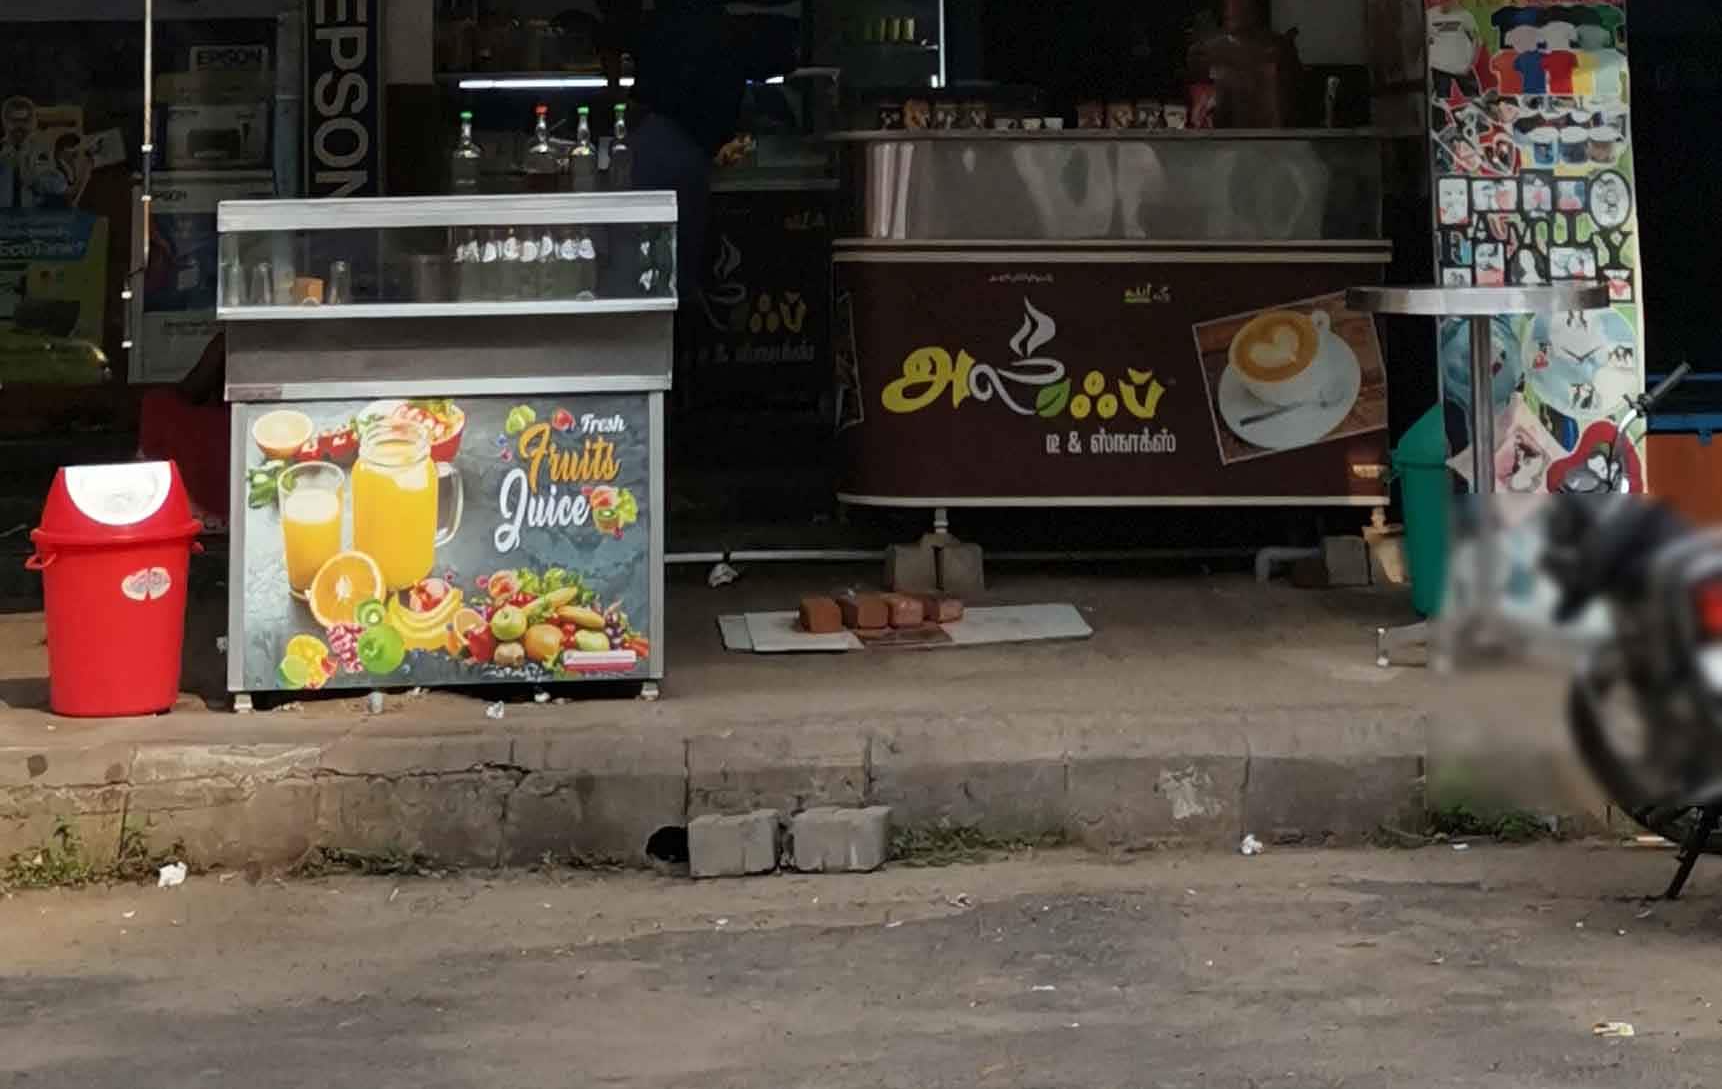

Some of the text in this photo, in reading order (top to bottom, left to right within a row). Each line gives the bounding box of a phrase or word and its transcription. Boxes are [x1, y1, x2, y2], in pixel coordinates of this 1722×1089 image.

[518, 422, 622, 495] Fruits
[581, 413, 626, 434] Fresh
[494, 467, 590, 552] Juice
